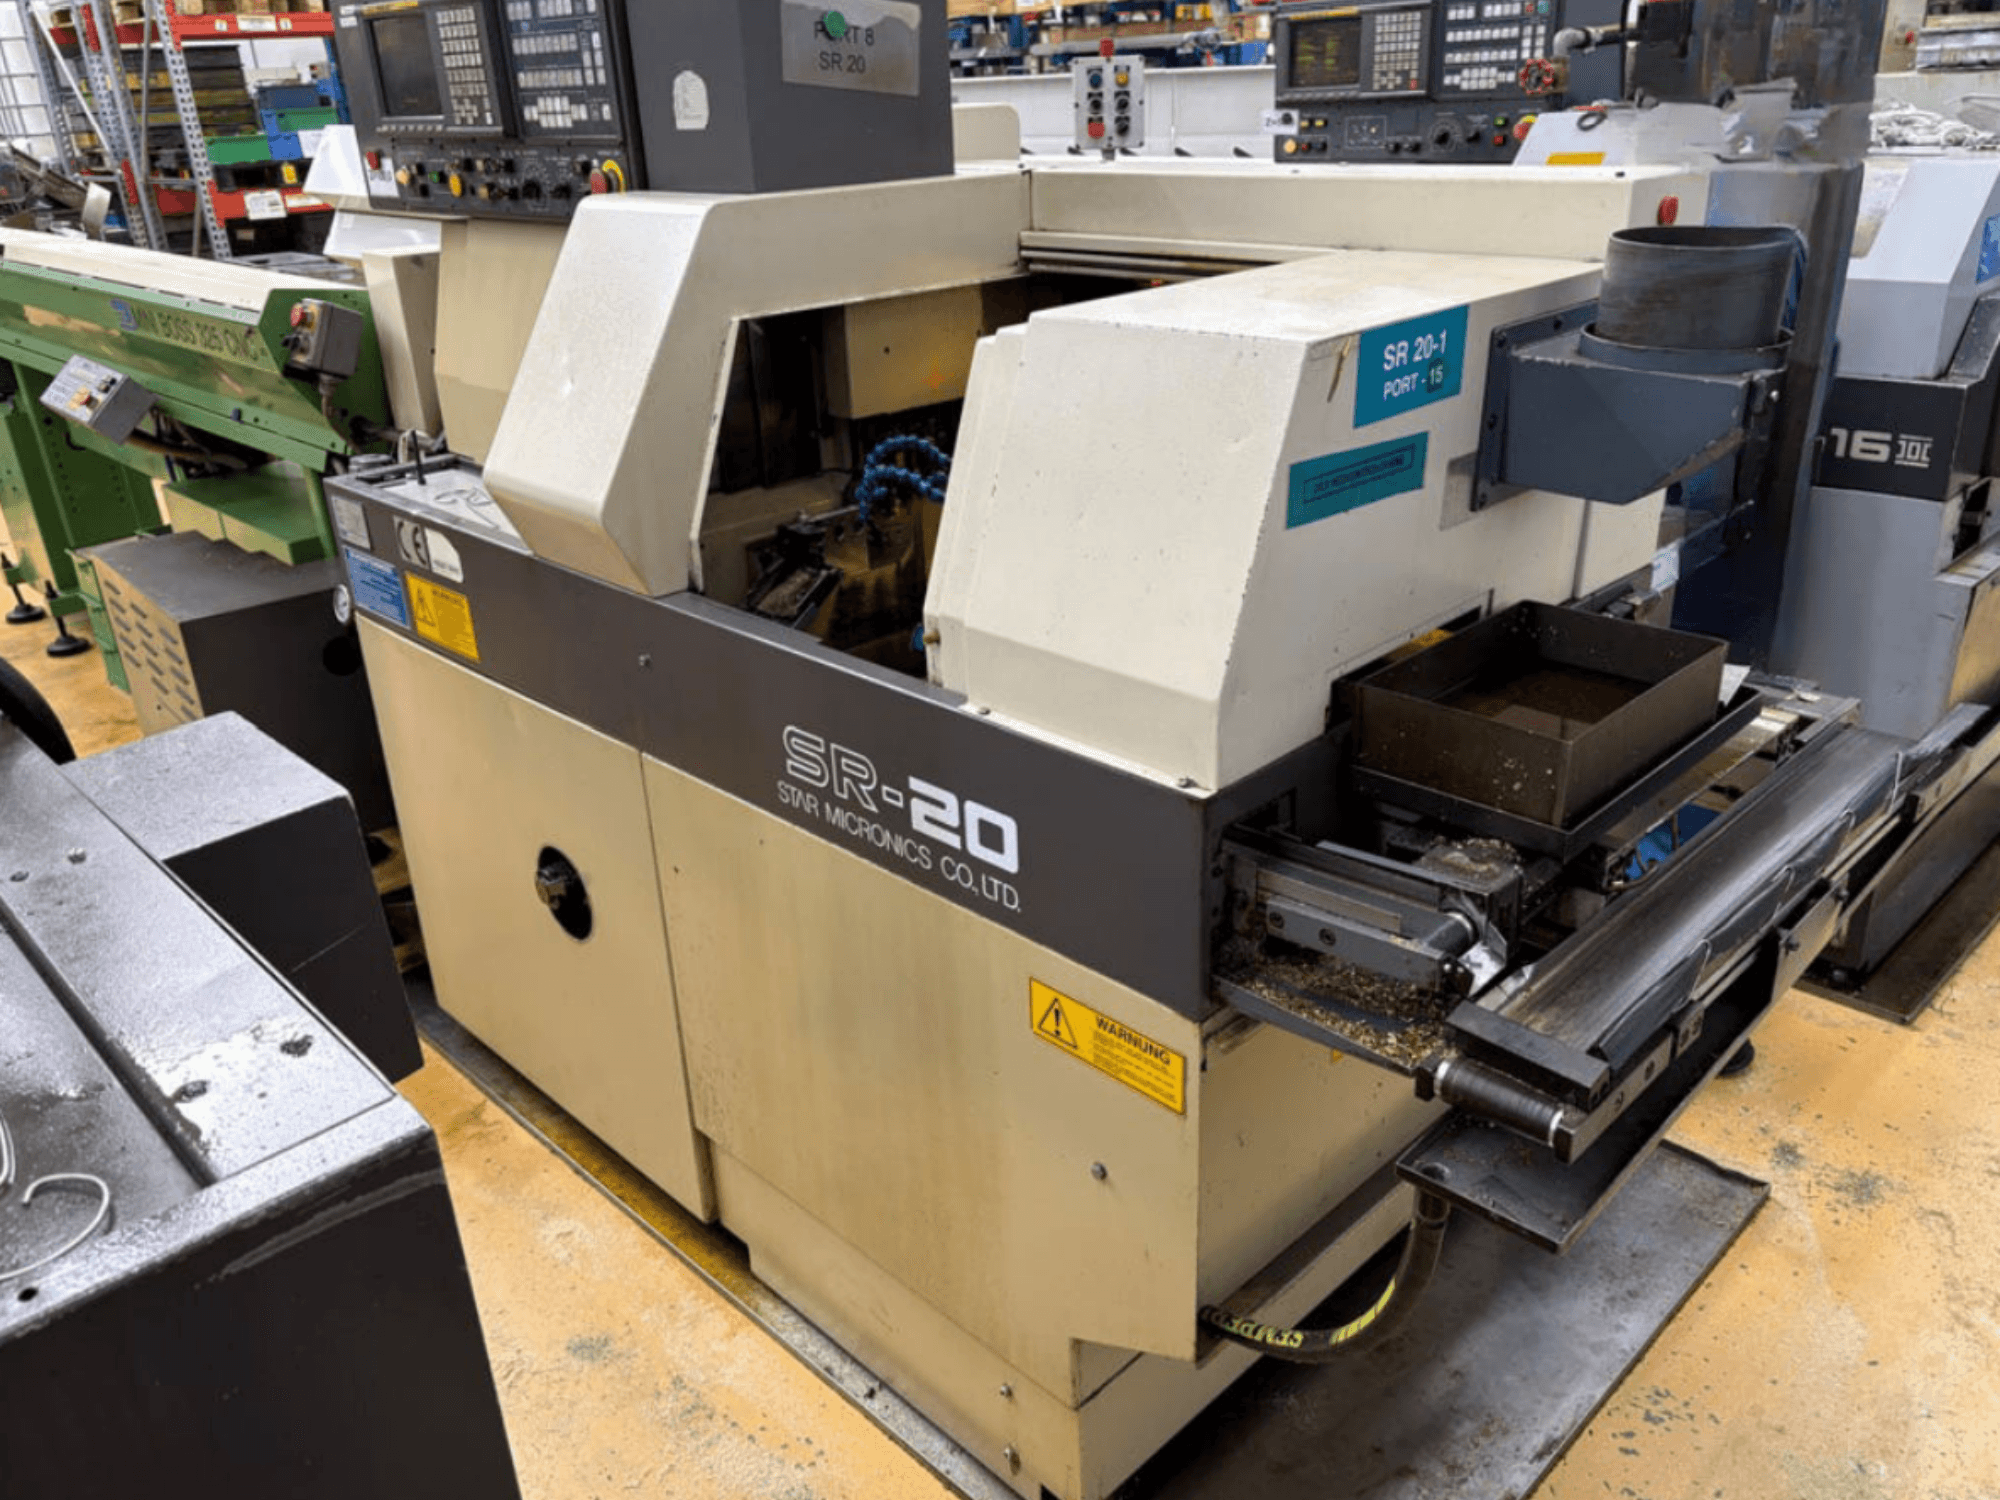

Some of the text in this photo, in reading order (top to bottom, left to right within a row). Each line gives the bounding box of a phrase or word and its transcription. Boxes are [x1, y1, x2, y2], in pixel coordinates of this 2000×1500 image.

[864, 26, 875, 46] 8
[819, 51, 867, 74] SR 20
[1382, 328, 1447, 371] SR 20-1
[1382, 372, 1419, 401] PORT
[1830, 427, 1893, 463] 16
[782, 725, 1019, 874] SR-20
[777, 780, 820, 819] STAR
[824, 802, 933, 870] MICRONICS
[1095, 1015, 1172, 1066] WARNUNG
